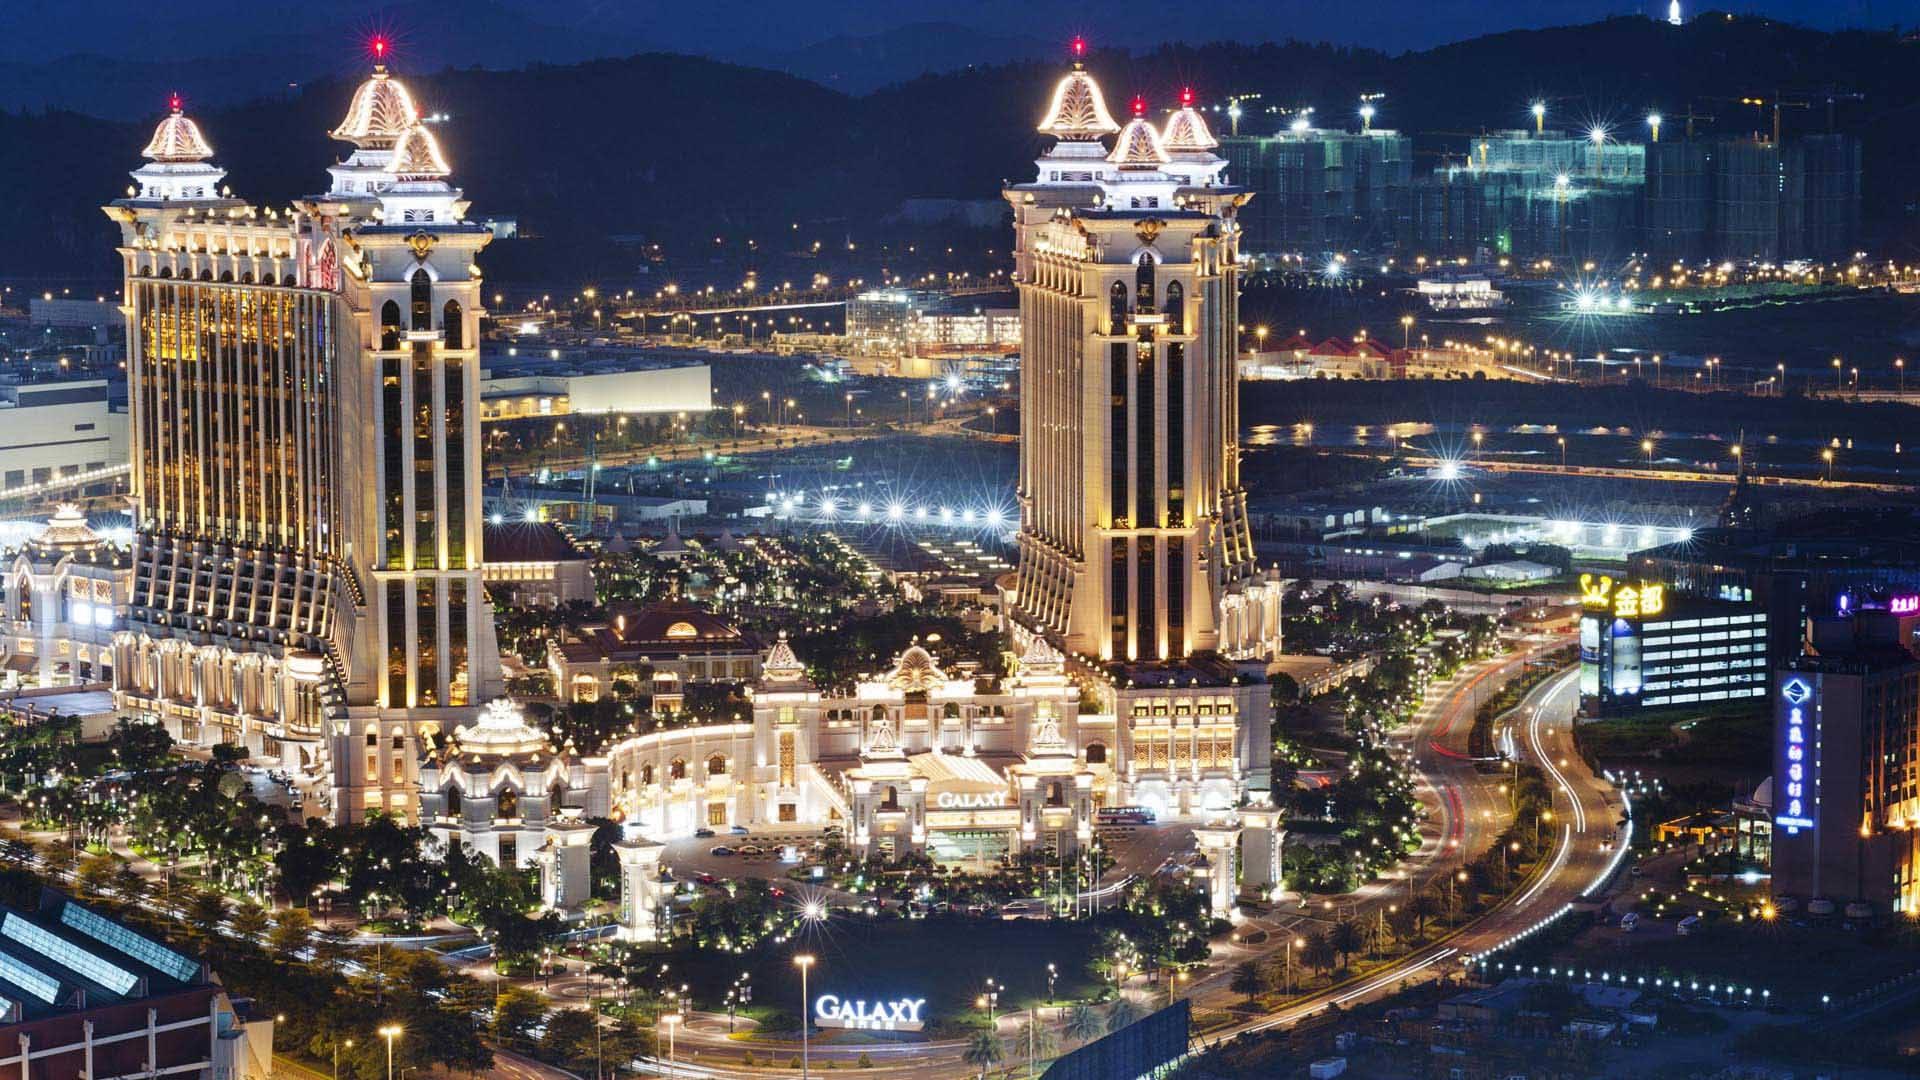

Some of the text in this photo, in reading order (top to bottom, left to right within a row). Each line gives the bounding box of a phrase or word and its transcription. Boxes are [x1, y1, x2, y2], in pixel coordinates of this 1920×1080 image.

[1615, 586, 1664, 616] 金都
[937, 791, 1009, 808] GALAXY
[816, 994, 926, 1022] GALAXY
